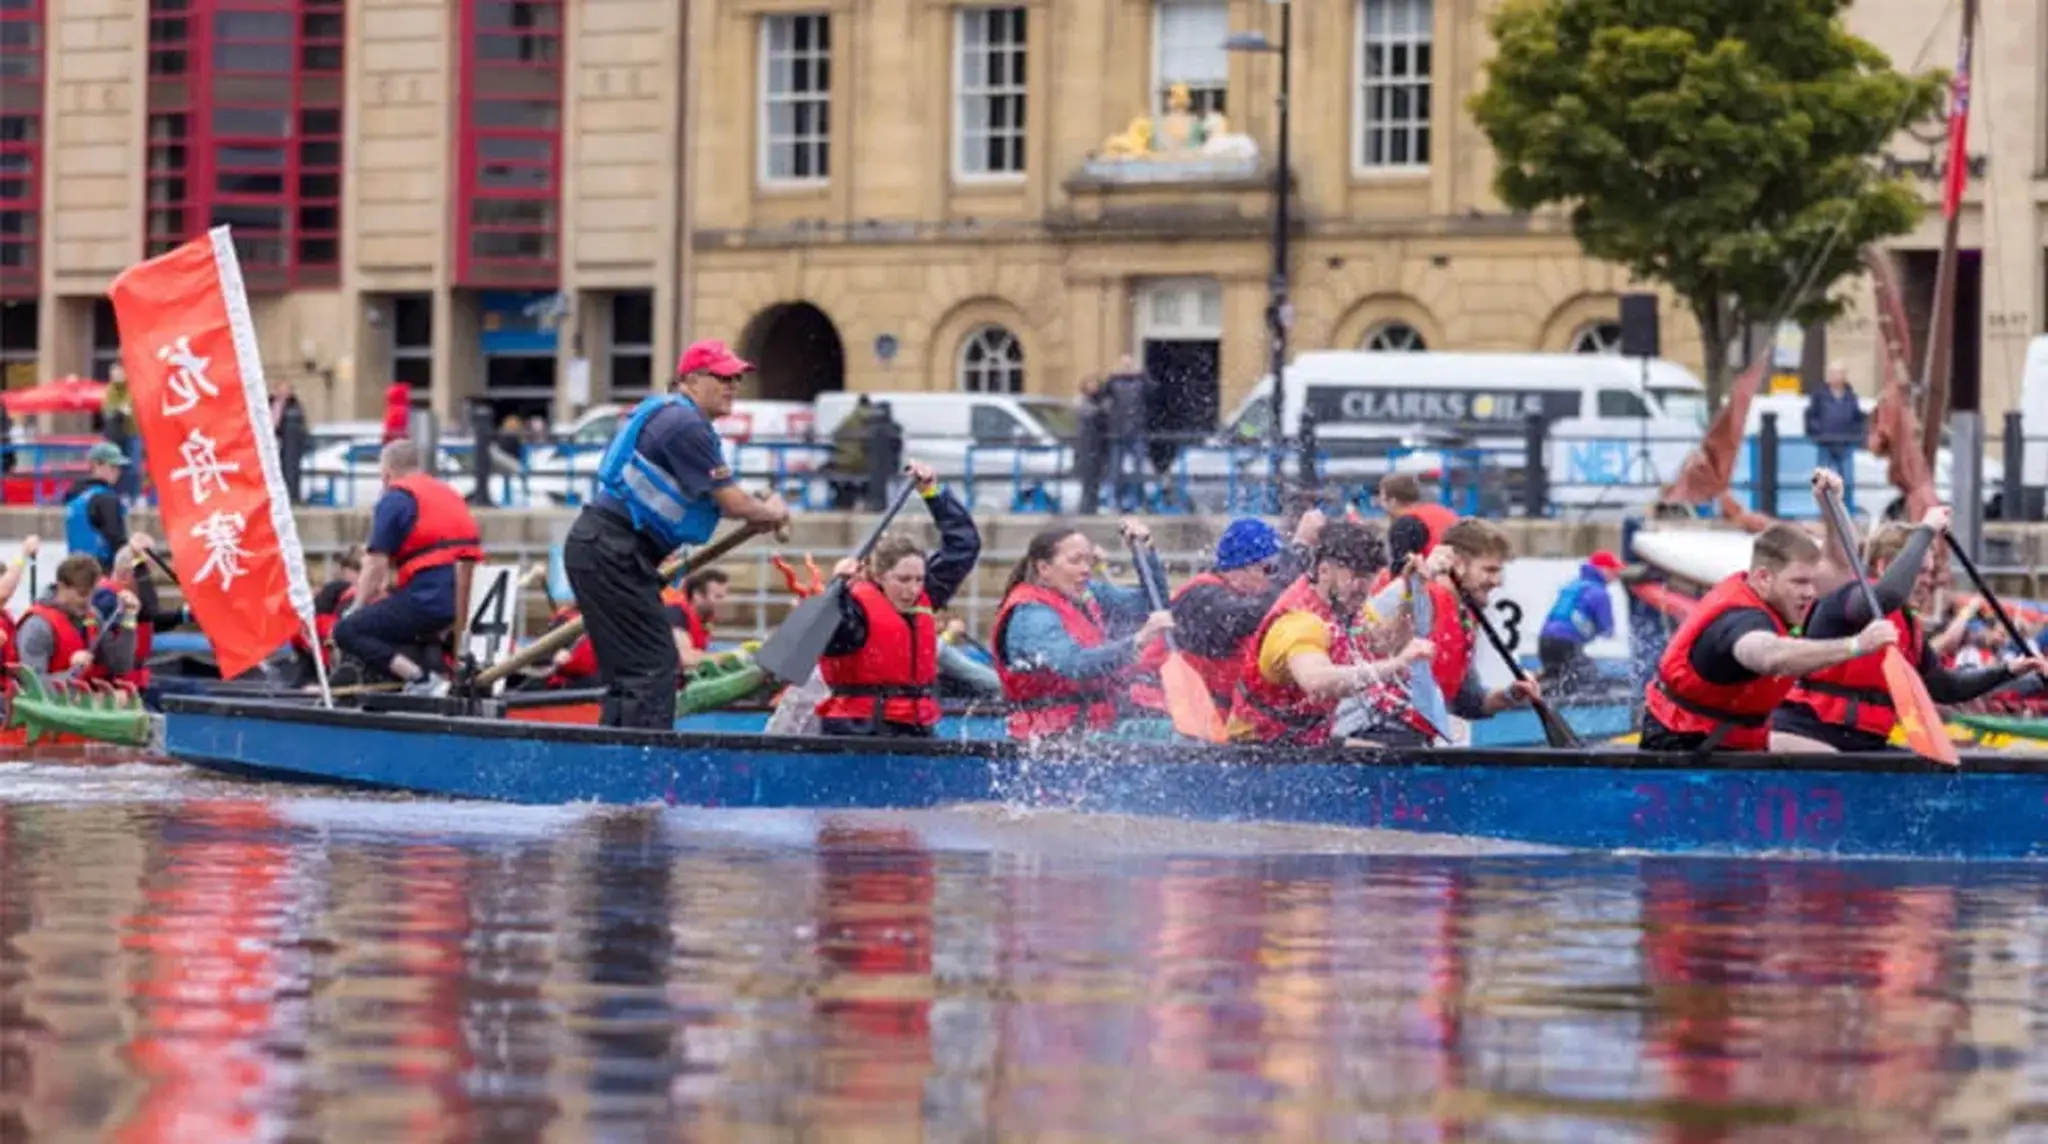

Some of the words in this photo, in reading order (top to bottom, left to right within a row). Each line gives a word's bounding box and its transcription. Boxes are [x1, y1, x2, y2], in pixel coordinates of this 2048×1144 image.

[1341, 390, 1467, 419] CLARKS
[470, 569, 509, 652] 4
[1495, 599, 1522, 651] 3
